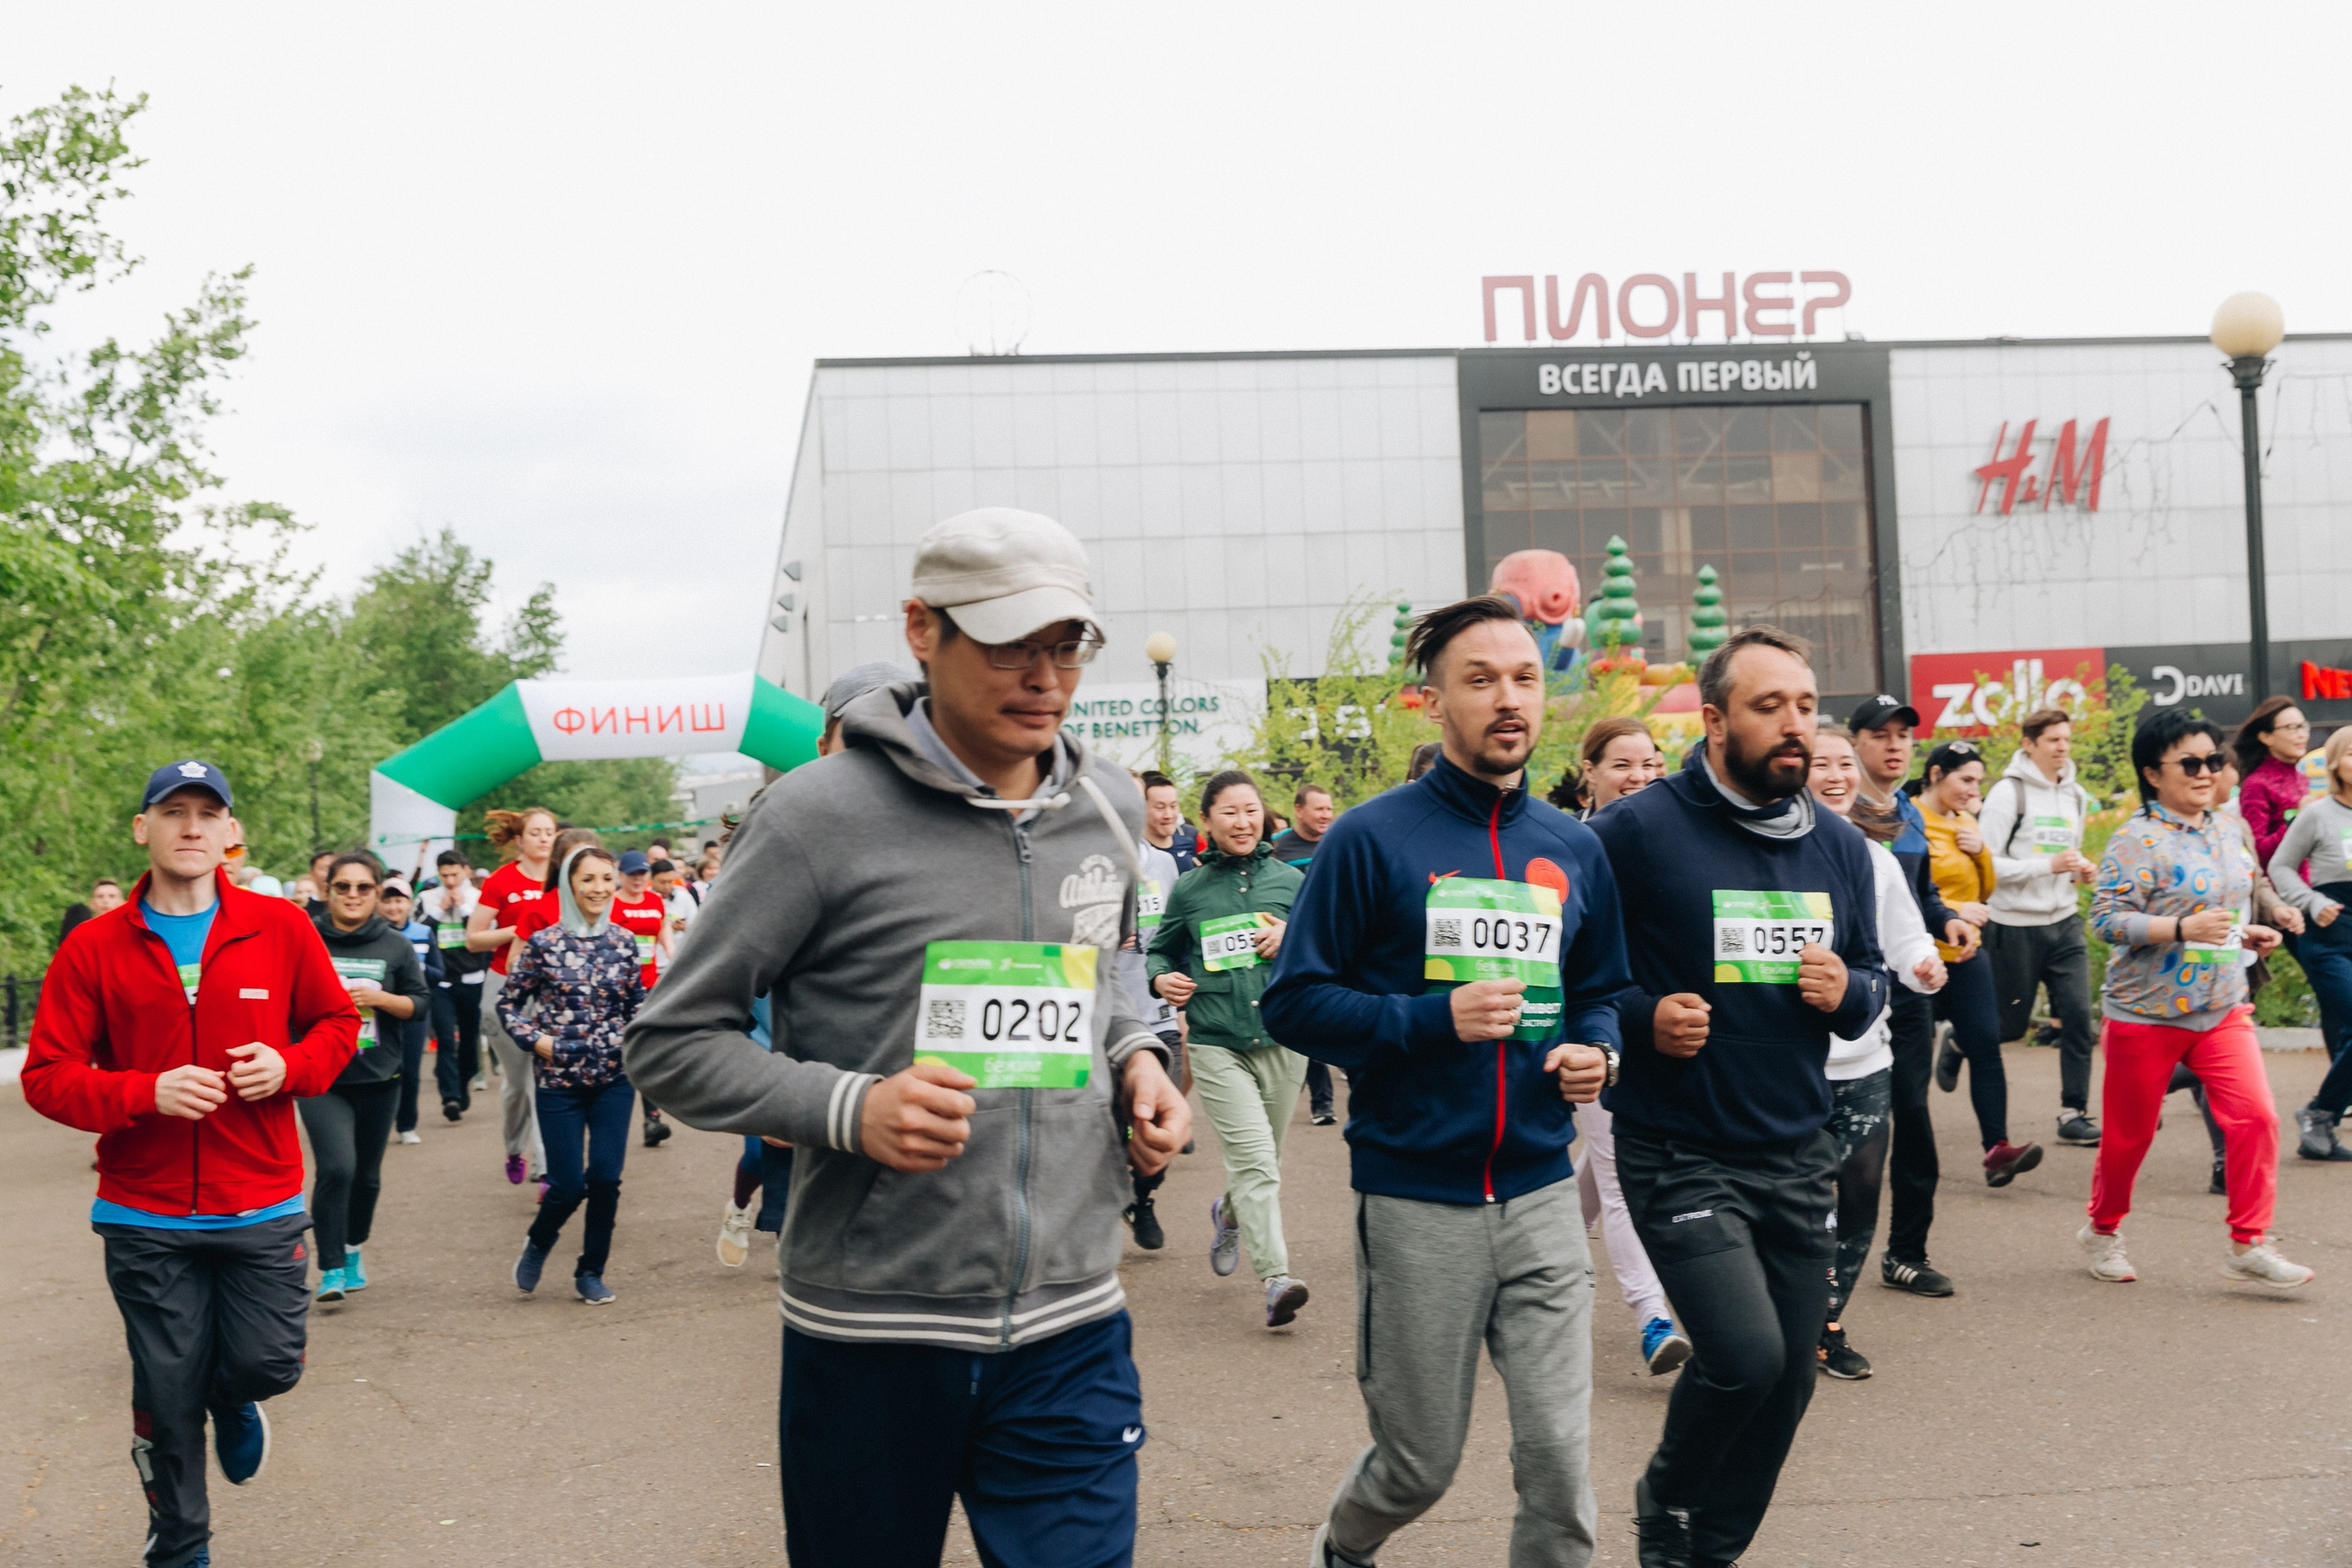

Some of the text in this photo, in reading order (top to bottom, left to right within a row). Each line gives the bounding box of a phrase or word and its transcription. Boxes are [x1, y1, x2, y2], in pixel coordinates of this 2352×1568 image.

[1482, 271, 1851, 342] ПИОНЕР
[1538, 351, 1817, 399] ВСЕГДА ПЕРВЫЙ
[1973, 416, 2111, 516] H&M
[1139, 695, 1220, 716] COLORS
[1932, 658, 2088, 728] zollo
[553, 702, 725, 735] ФИНИШ
[1474, 917, 1551, 953] 0037
[1755, 926, 1824, 954] 0557
[982, 998, 1081, 1043] 0202
